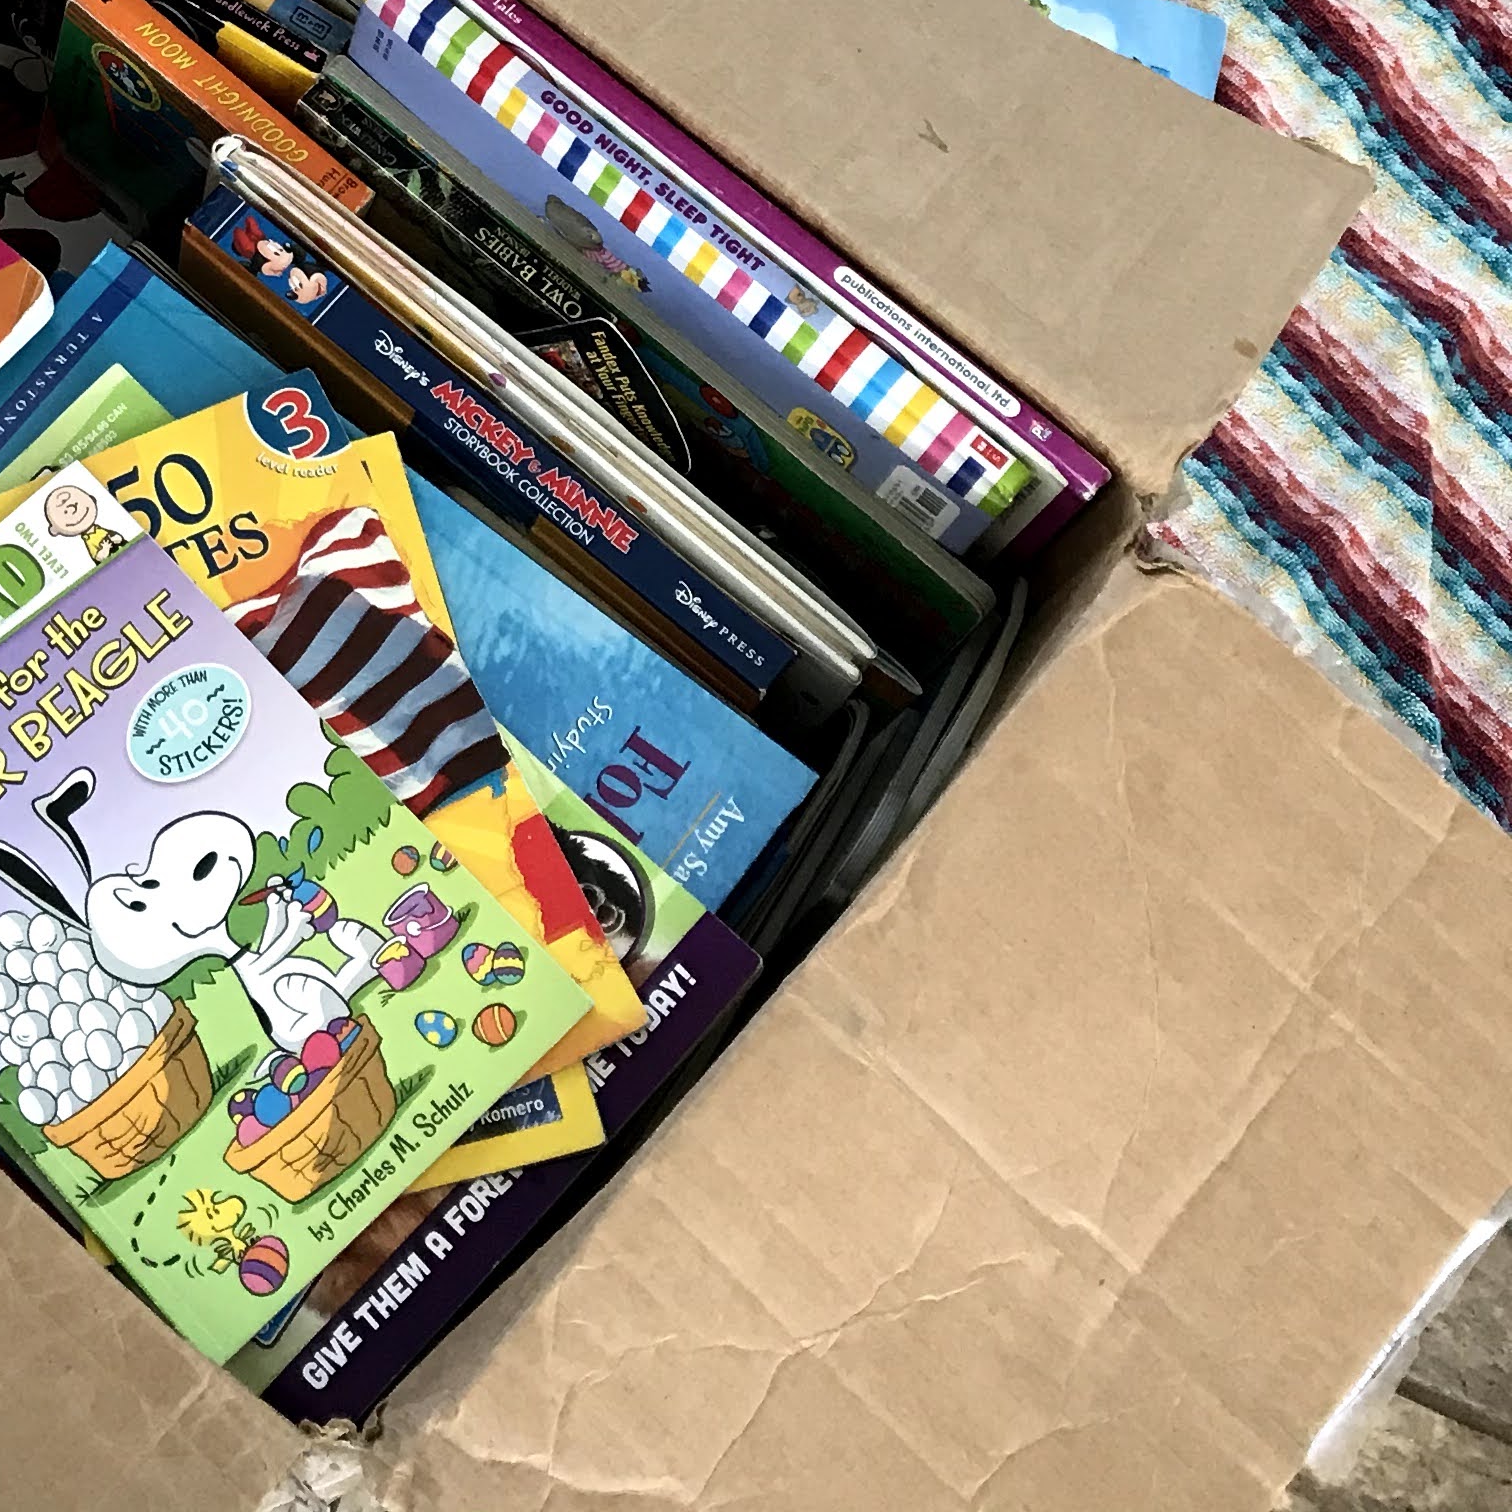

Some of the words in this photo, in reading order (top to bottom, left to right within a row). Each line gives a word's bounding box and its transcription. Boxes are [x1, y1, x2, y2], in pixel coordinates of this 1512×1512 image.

[135, 22, 199, 70] MOON
[273, 24, 300, 51] Press
[193, 74, 309, 162] GOODNIGHT
[540, 90, 594, 134] GOOD
[594, 133, 653, 186] NIGHT,
[654, 182, 708, 225] SLEEP
[709, 223, 766, 272] TIGHT
[474, 226, 538, 283] BABIES
[538, 281, 583, 320] OWL
[541, 267, 581, 301] WADDELL
[841, 274, 913, 331] publications
[586, 351, 599, 364] at
[595, 366, 617, 392] Your
[591, 331, 622, 375] Fandex
[621, 374, 637, 402] Puts
[106, 402, 128, 425] CAN
[262, 387, 331, 460] 3
[256, 452, 288, 476] level
[293, 464, 339, 479] reader
[430, 379, 535, 466] MICKEY
[536, 467, 639, 555] MINNIE
[443, 417, 521, 484] STORYBOOK
[518, 479, 595, 546] COLLECTION
[14, 522, 37, 548] TWO
[38, 545, 70, 579] LEVEL
[42, 605, 106, 659] the
[718, 626, 765, 667] PRESS
[8, 588, 193, 761] BEAGLE
[132, 709, 153, 738] WITH
[147, 681, 179, 713] MORE
[178, 670, 208, 688] THAN
[158, 698, 209, 740] 40
[159, 698, 244, 776] STICKERS!
[694, 796, 745, 855] Amy
[308, 1226, 335, 1242] by
[327, 1158, 397, 1221] Charles
[389, 1133, 421, 1164] M.
[412, 1080, 474, 1138] Schulz
[302, 1320, 363, 1390] GIVE
[353, 1252, 431, 1331] THEM
[425, 1231, 453, 1261] A
